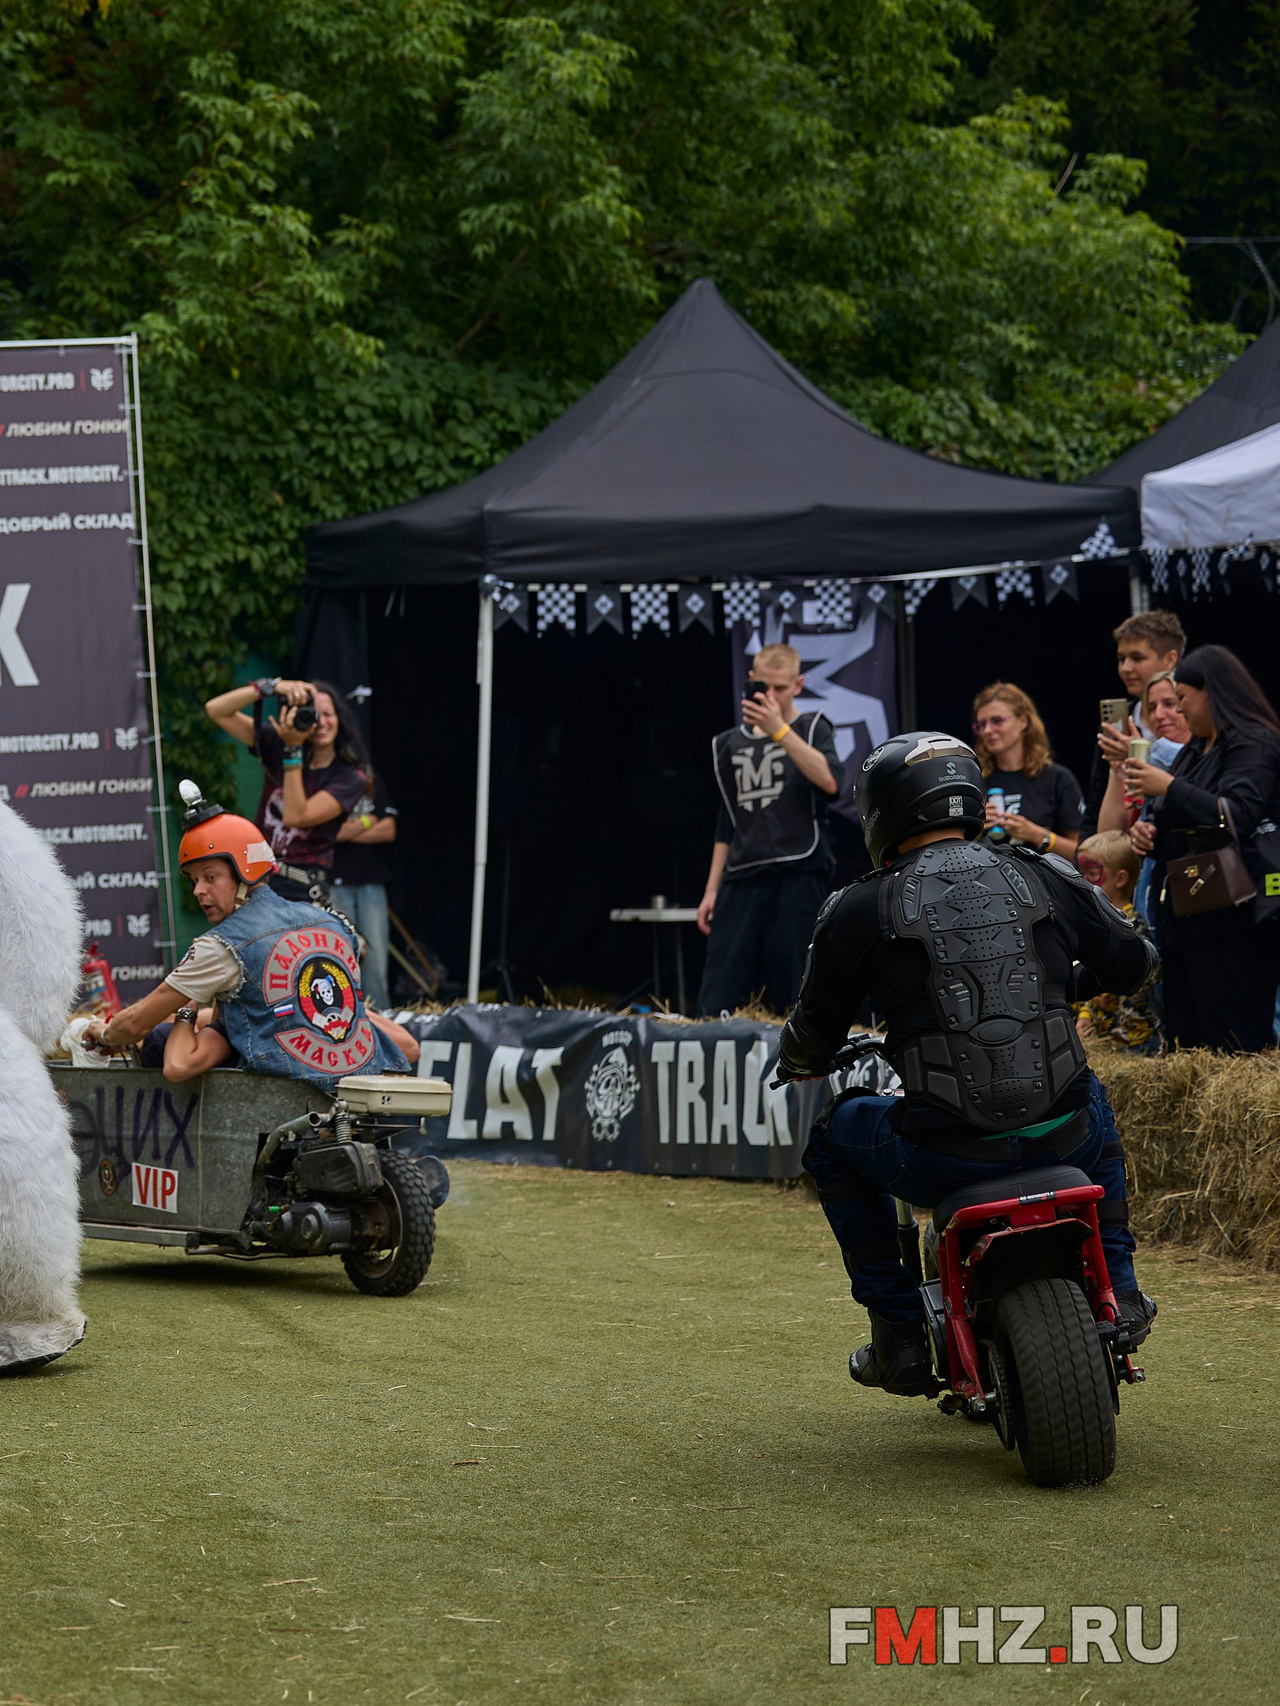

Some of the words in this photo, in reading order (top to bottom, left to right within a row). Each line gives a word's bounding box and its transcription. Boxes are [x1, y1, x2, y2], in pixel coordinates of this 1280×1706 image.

[6, 421, 72, 438] ЛЮБИМ
[73, 512, 136, 532] СКЛАД
[30, 779, 96, 798] ЛЮБИМ
[98, 776, 153, 794] ГОНКИ
[98, 871, 159, 889] СКЛАД
[111, 964, 166, 981] ГОНКИ
[417, 1040, 565, 1141] FLAT
[135, 1165, 176, 1210] VIP
